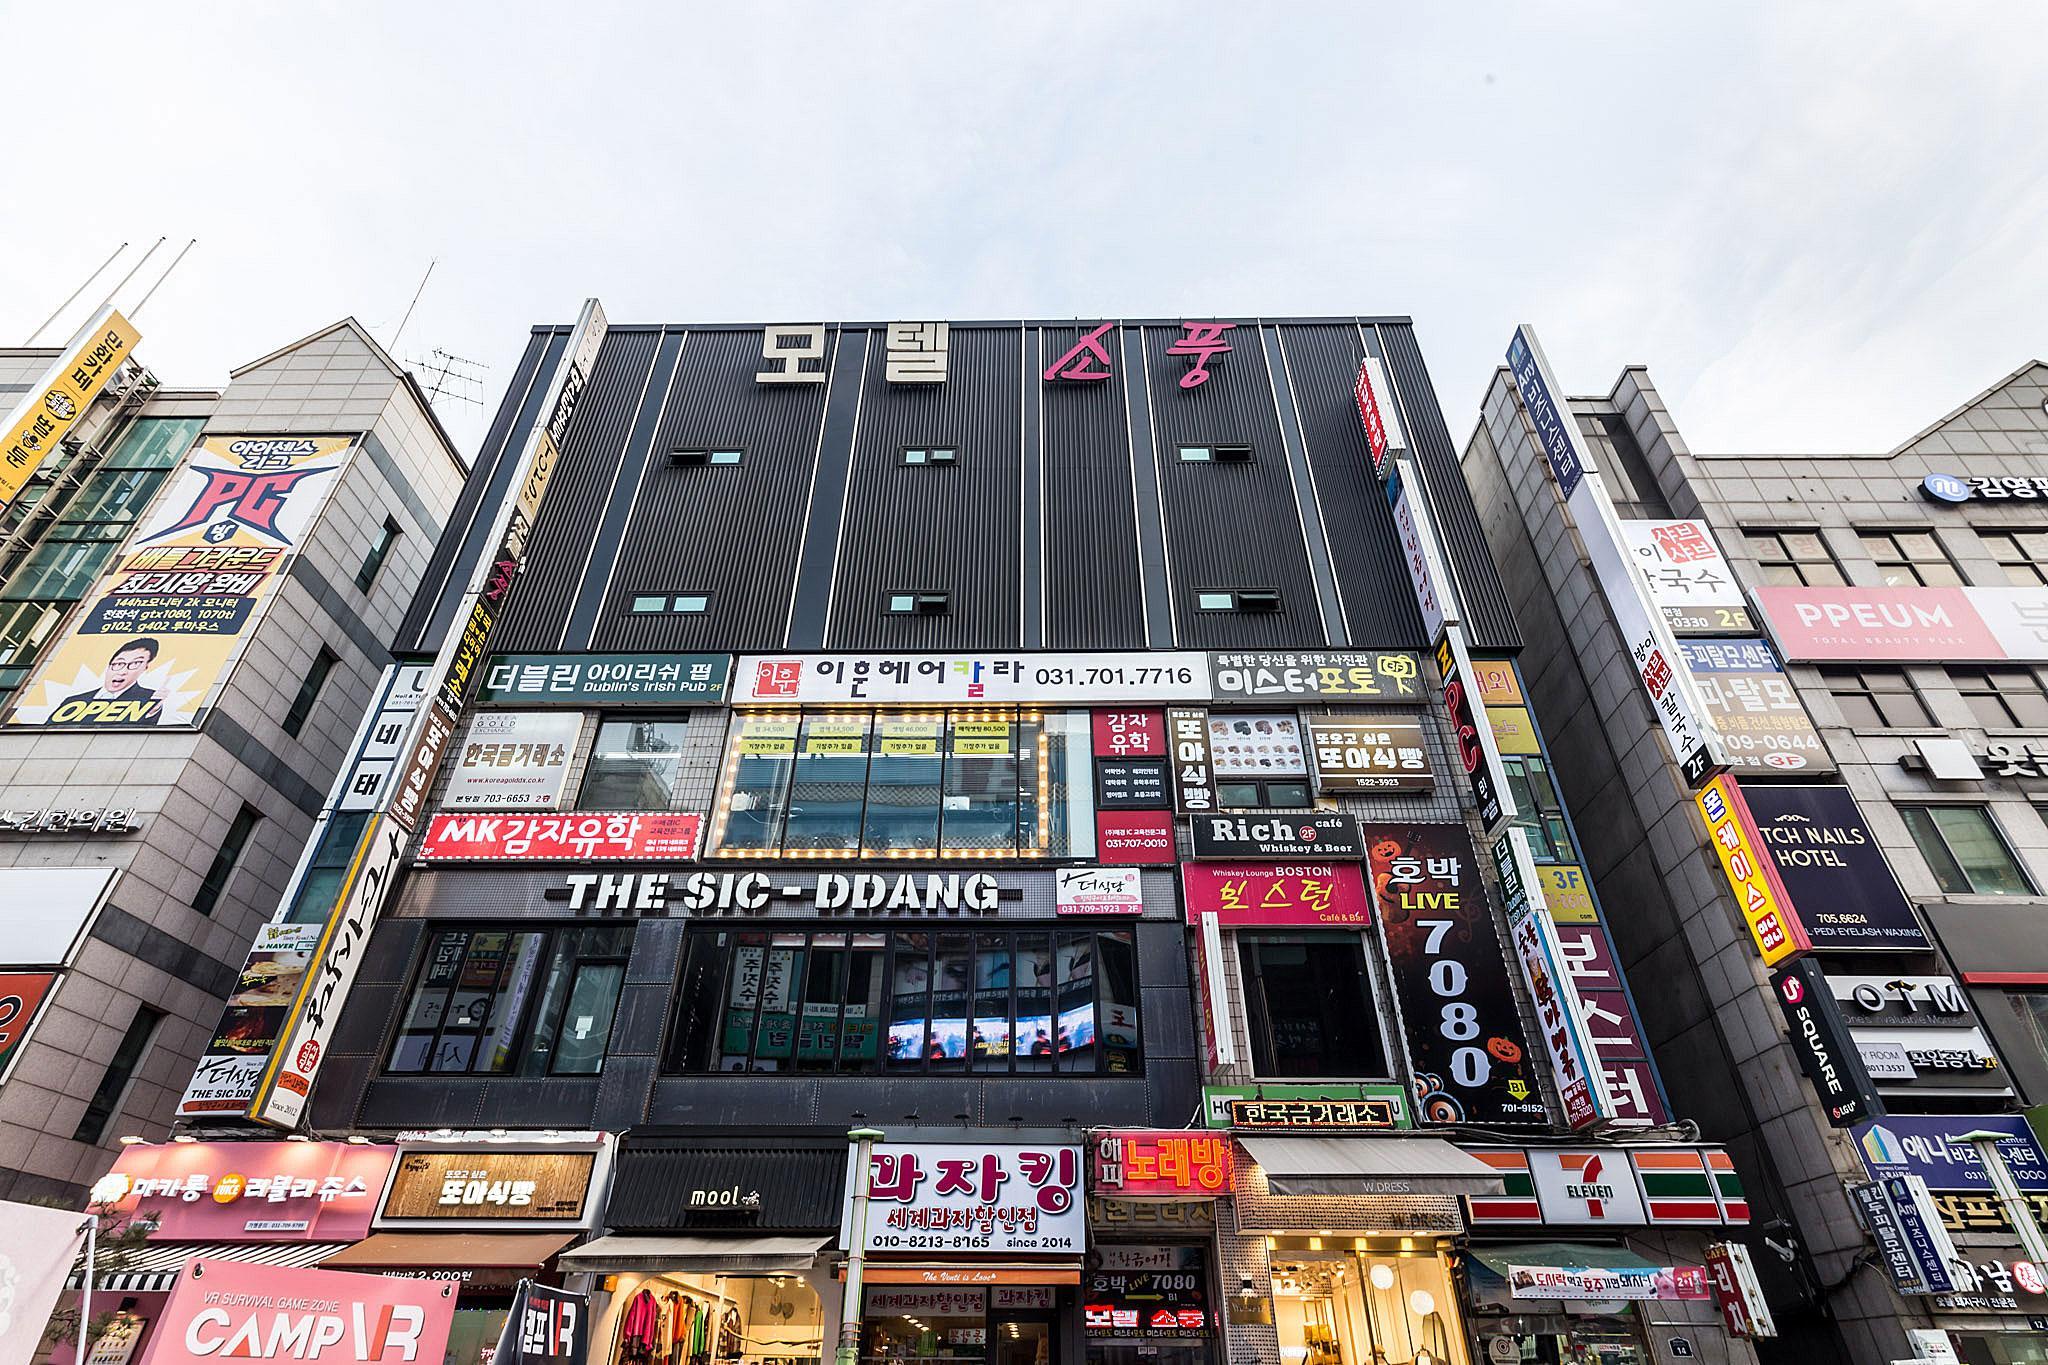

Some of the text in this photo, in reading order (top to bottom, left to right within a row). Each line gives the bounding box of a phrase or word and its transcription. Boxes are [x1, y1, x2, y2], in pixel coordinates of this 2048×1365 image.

[72, 330, 122, 391] 만화카페
[755, 321, 1238, 389] 모텔 소풍
[1518, 357, 1536, 392] Any
[1527, 379, 1576, 478] 비즈니스센터
[230, 440, 318, 457] 아이센스
[170, 469, 305, 532] PC
[209, 524, 233, 542] 방
[204, 598, 240, 609] 모니터
[1714, 608, 1748, 628] 2F
[1793, 603, 1953, 629] PPEUM
[137, 622, 168, 635] g402
[1811, 636, 1966, 645] TOTAL PLEX
[1217, 653, 1368, 668] 특별한 당신을 위한 사진관
[448, 646, 474, 698] 거래소
[486, 664, 581, 692] 더블린
[587, 663, 680, 682] 아이리쉬
[816, 660, 1192, 698] 이훈헤어칼라 031.701.7716
[1217, 667, 1381, 696] 미스터포토
[583, 682, 723, 693] Dublin's Irish Pub 2F
[51, 699, 154, 723] OPEN
[477, 720, 516, 728] GOLD
[1107, 713, 1149, 733] 감자
[1444, 680, 1482, 774] PC
[1109, 732, 1151, 755] 유학
[1315, 732, 1392, 745] 또오고 싶은
[462, 743, 566, 768] 한국금거래소
[1177, 720, 1211, 809] 또아식빵
[1318, 747, 1426, 769] 또아식빵
[1768, 755, 1802, 766] 3F
[400, 723, 444, 814] 또아식빵
[1687, 755, 1706, 780] 2F
[1355, 778, 1400, 787] 1522-3923
[484, 794, 530, 803] 703-6653
[438, 816, 644, 859] MK 감자유학
[1212, 820, 1296, 841] Rich
[1315, 818, 1344, 828] café
[1808, 827, 1866, 846] NAILS
[1106, 839, 1168, 848] 031-707-0010
[1259, 844, 1353, 853] Whiskey & Beer
[1703, 787, 1766, 912] 폰케이스
[1496, 836, 1520, 896] 더블린
[1780, 849, 1848, 868] HOTEL
[1212, 866, 1333, 878] Whiskey Lounge BOSTON
[1390, 857, 1462, 886] 호박
[1556, 870, 1580, 890] 3F
[566, 872, 1000, 910] THE SIC DDANG
[1400, 892, 1460, 910] LIVE
[1062, 905, 1139, 914] 031.709-1923 2F
[1319, 913, 1340, 922] Café
[1816, 913, 1868, 924] 705.6624
[1757, 916, 1778, 935] 미니
[1763, 929, 1785, 949] 미니
[1416, 919, 1492, 1088] 7080
[1796, 1005, 1843, 1096] SQUARE
[1870, 1050, 1900, 1060] ROOM
[190, 1090, 232, 1099] THE SIC
[1510, 1081, 1526, 1094] B1
[1245, 1104, 1379, 1126] 한국금거래소
[1501, 1103, 1545, 1114] 701-9152
[1902, 1133, 1955, 1166] 애니
[1100, 1138, 1123, 1188] 해피
[1127, 1138, 1225, 1188] 노래방
[131, 1175, 210, 1202] 마카롱
[214, 1184, 241, 1196] JUICE
[244, 1175, 367, 1203] 러블리 쥬스
[869, 1148, 1078, 1213] 과자킹
[1363, 1182, 1410, 1193] W.DRESS
[439, 1180, 536, 1206] 또아식빵
[690, 1186, 739, 1206] mool
[887, 1206, 1037, 1234] 세계과자할인점
[1897, 1203, 1918, 1219] Any
[872, 1235, 1072, 1248] 010-8213-8765 since 2014
[922, 1271, 991, 1282] The Venti is Love
[1093, 1273, 1196, 1294] 호박 LIVE 7080
[204, 1292, 339, 1313] VR SURVIVAL GAME ZONE
[871, 1292, 984, 1313] 세계과자할인점
[998, 1288, 1050, 1307] 과자킹
[185, 1307, 346, 1361] CAMP
[2034, 1320, 2044, 1329] 12
[1677, 1346, 1687, 1355] 14
